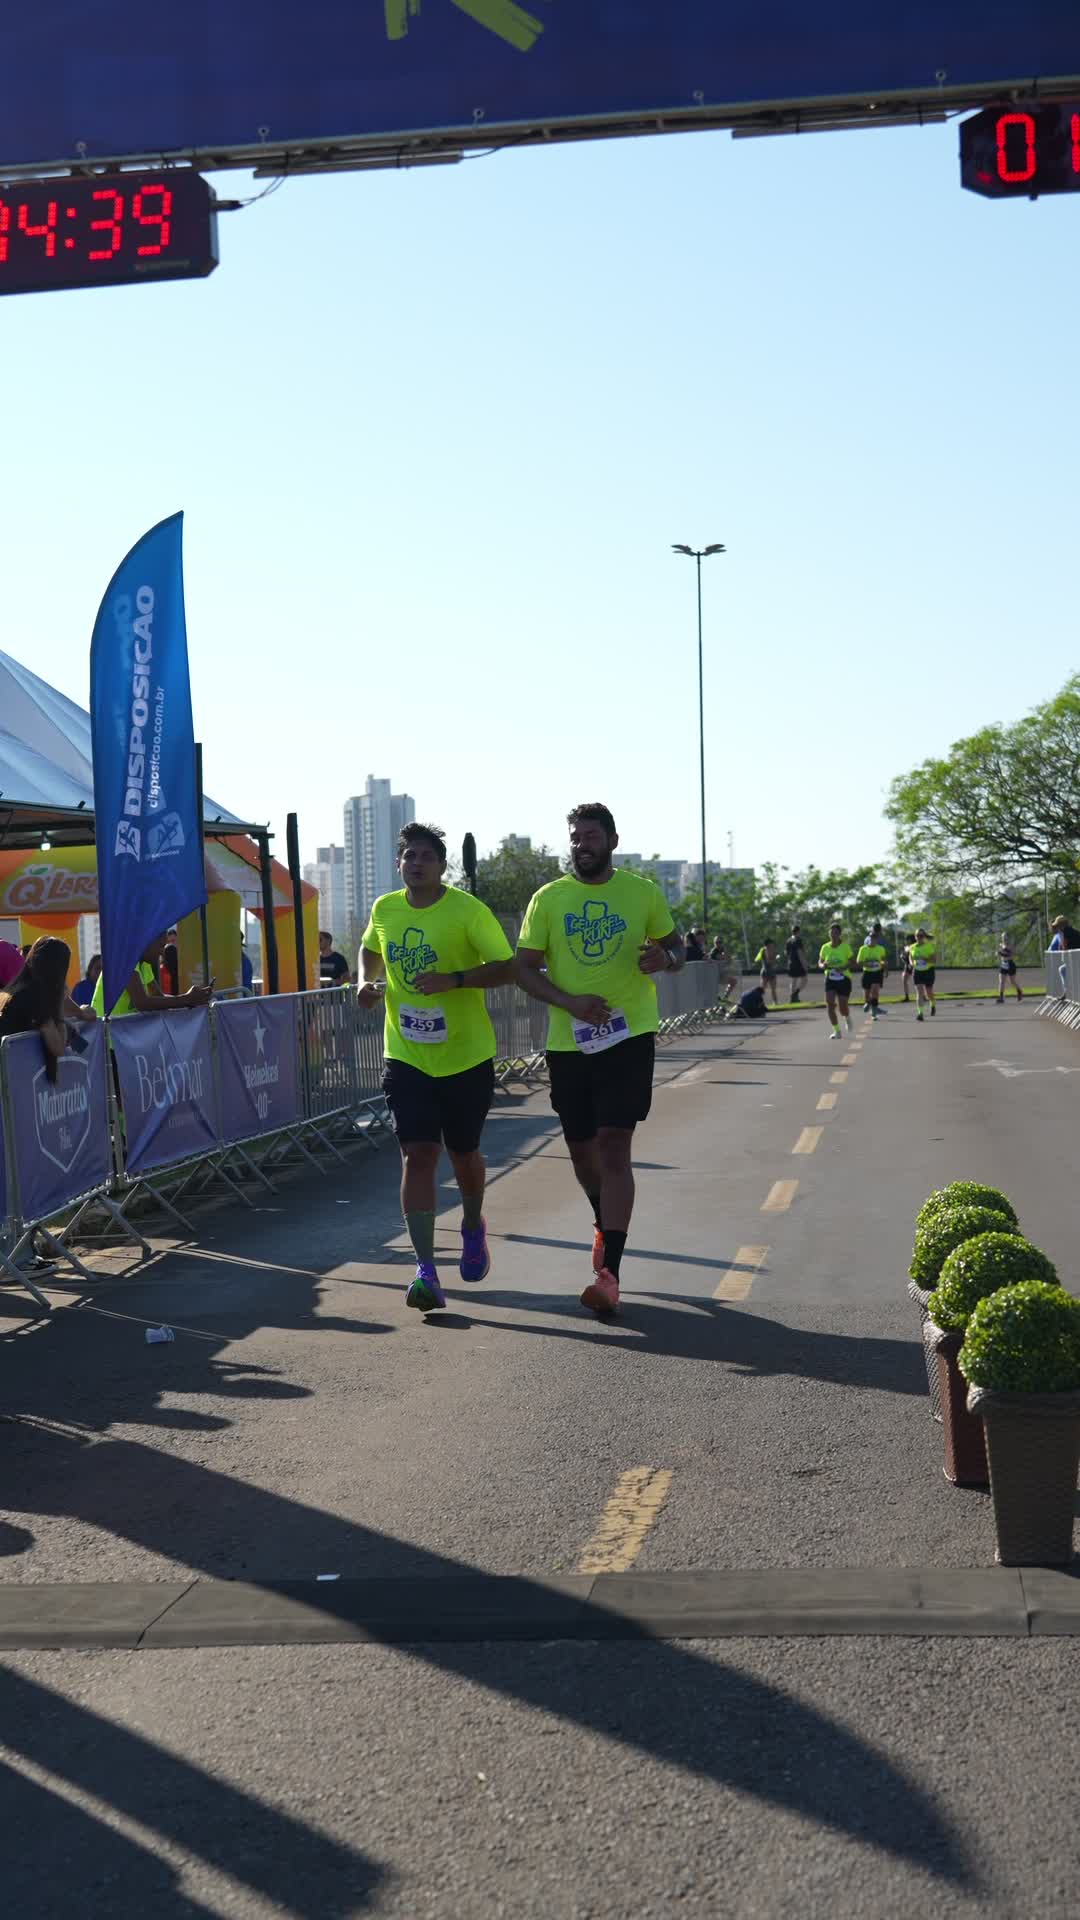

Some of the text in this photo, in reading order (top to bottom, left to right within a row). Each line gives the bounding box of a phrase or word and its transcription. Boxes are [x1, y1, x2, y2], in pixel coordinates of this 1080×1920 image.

[583, 924, 612, 944] RUN
[402, 954, 426, 972] RUN
[410, 1018, 435, 1031] 259
[591, 1020, 614, 1039] 261
